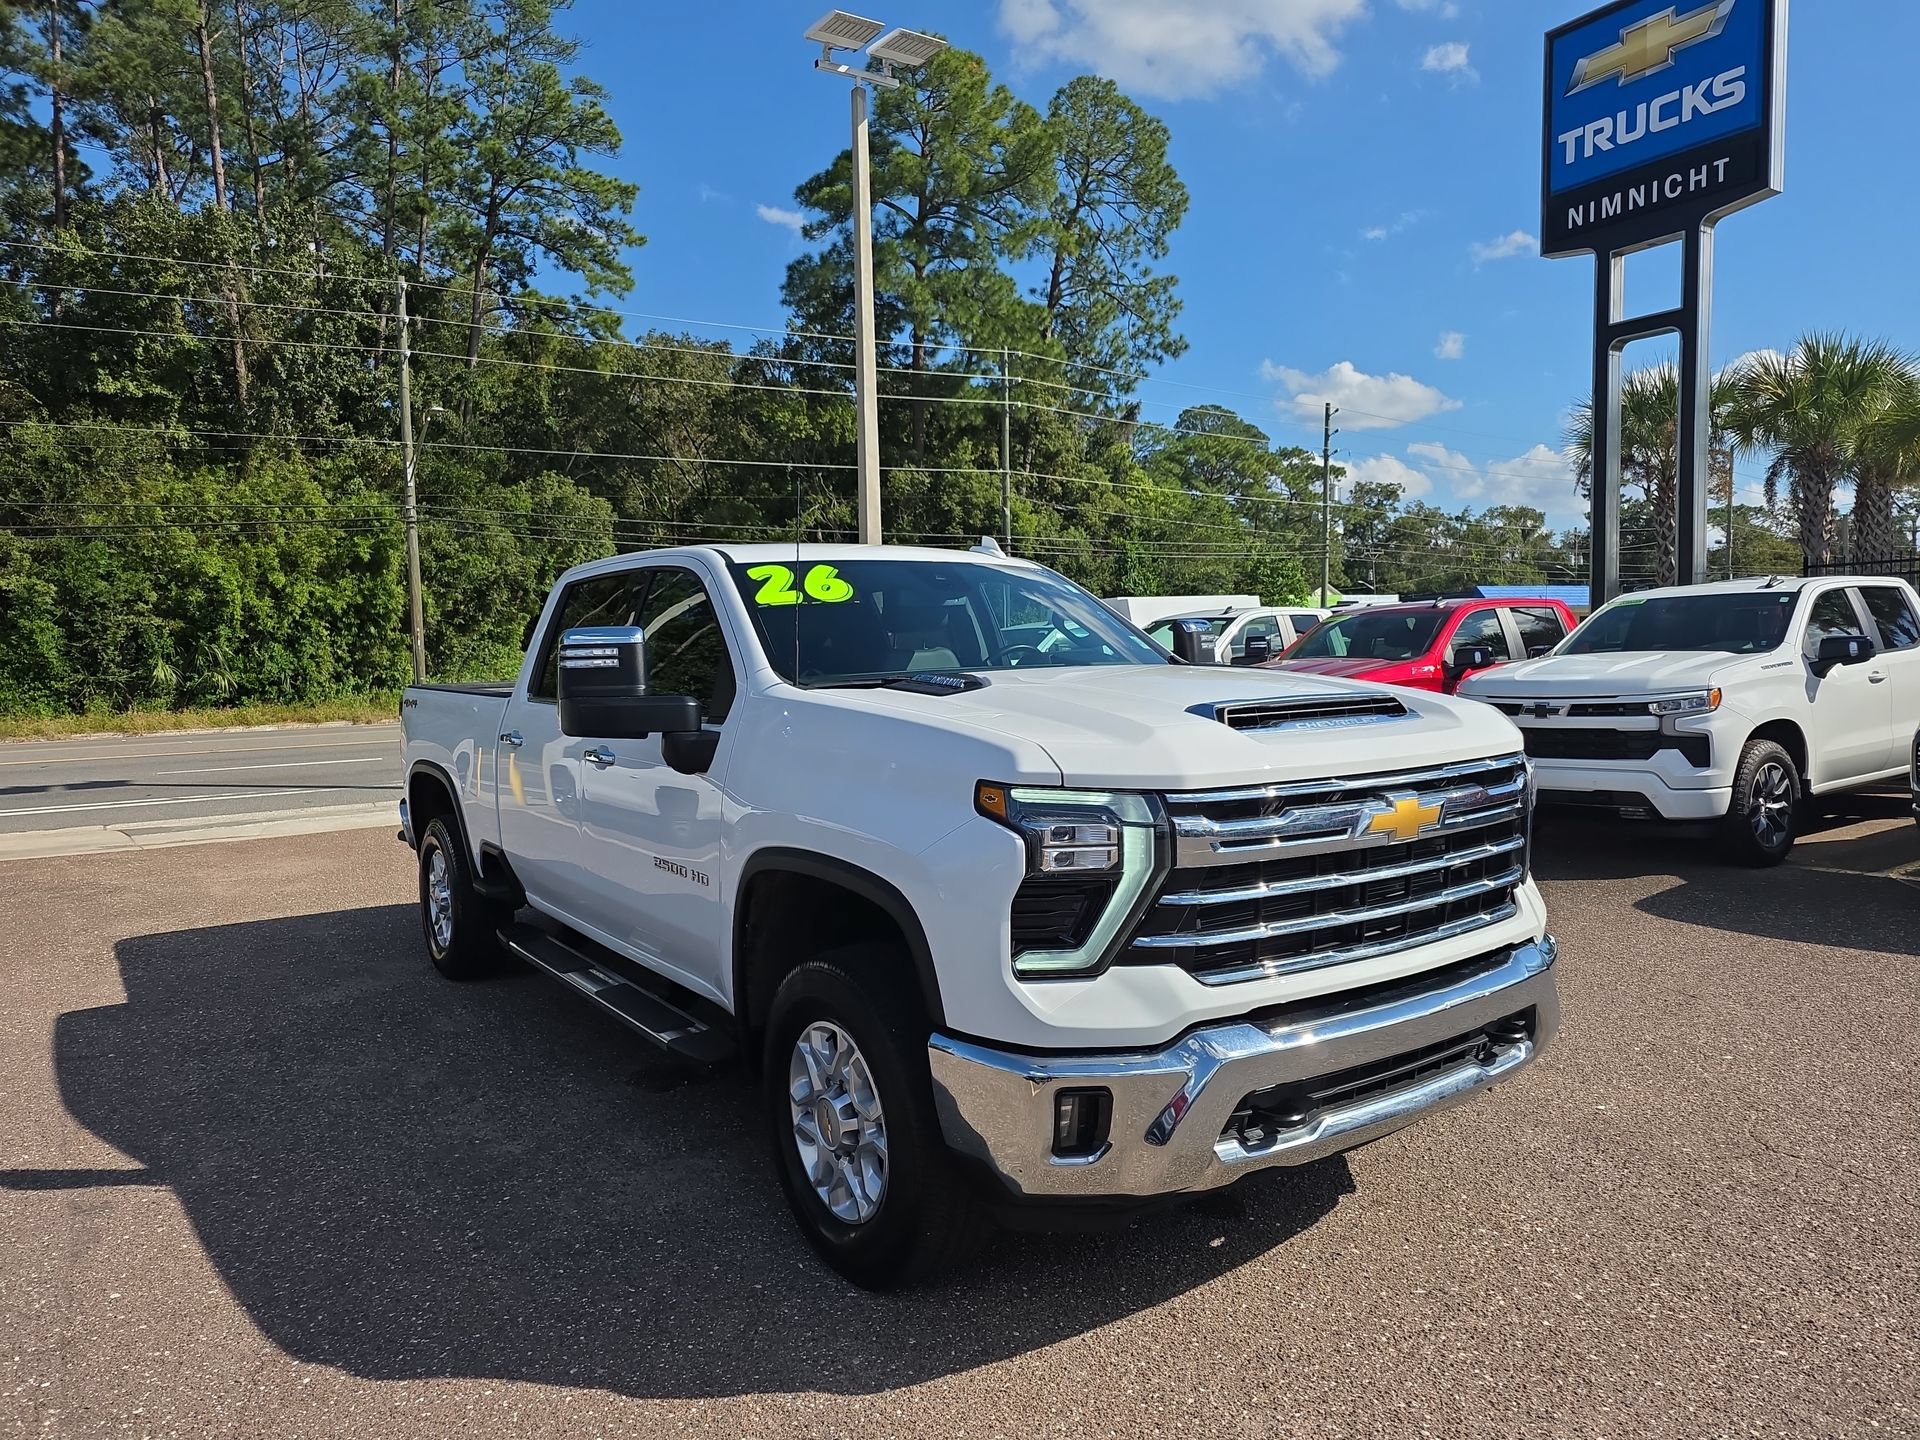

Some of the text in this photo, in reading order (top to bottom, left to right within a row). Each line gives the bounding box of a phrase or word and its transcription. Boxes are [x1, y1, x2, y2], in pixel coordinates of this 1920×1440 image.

[1558, 65, 1746, 165] TRUCKS
[1568, 157, 1730, 230] NIMNICHT
[746, 564, 854, 606] 26
[1296, 716, 1378, 730] CHEVROLET
[653, 856, 709, 887] 2500 HD
